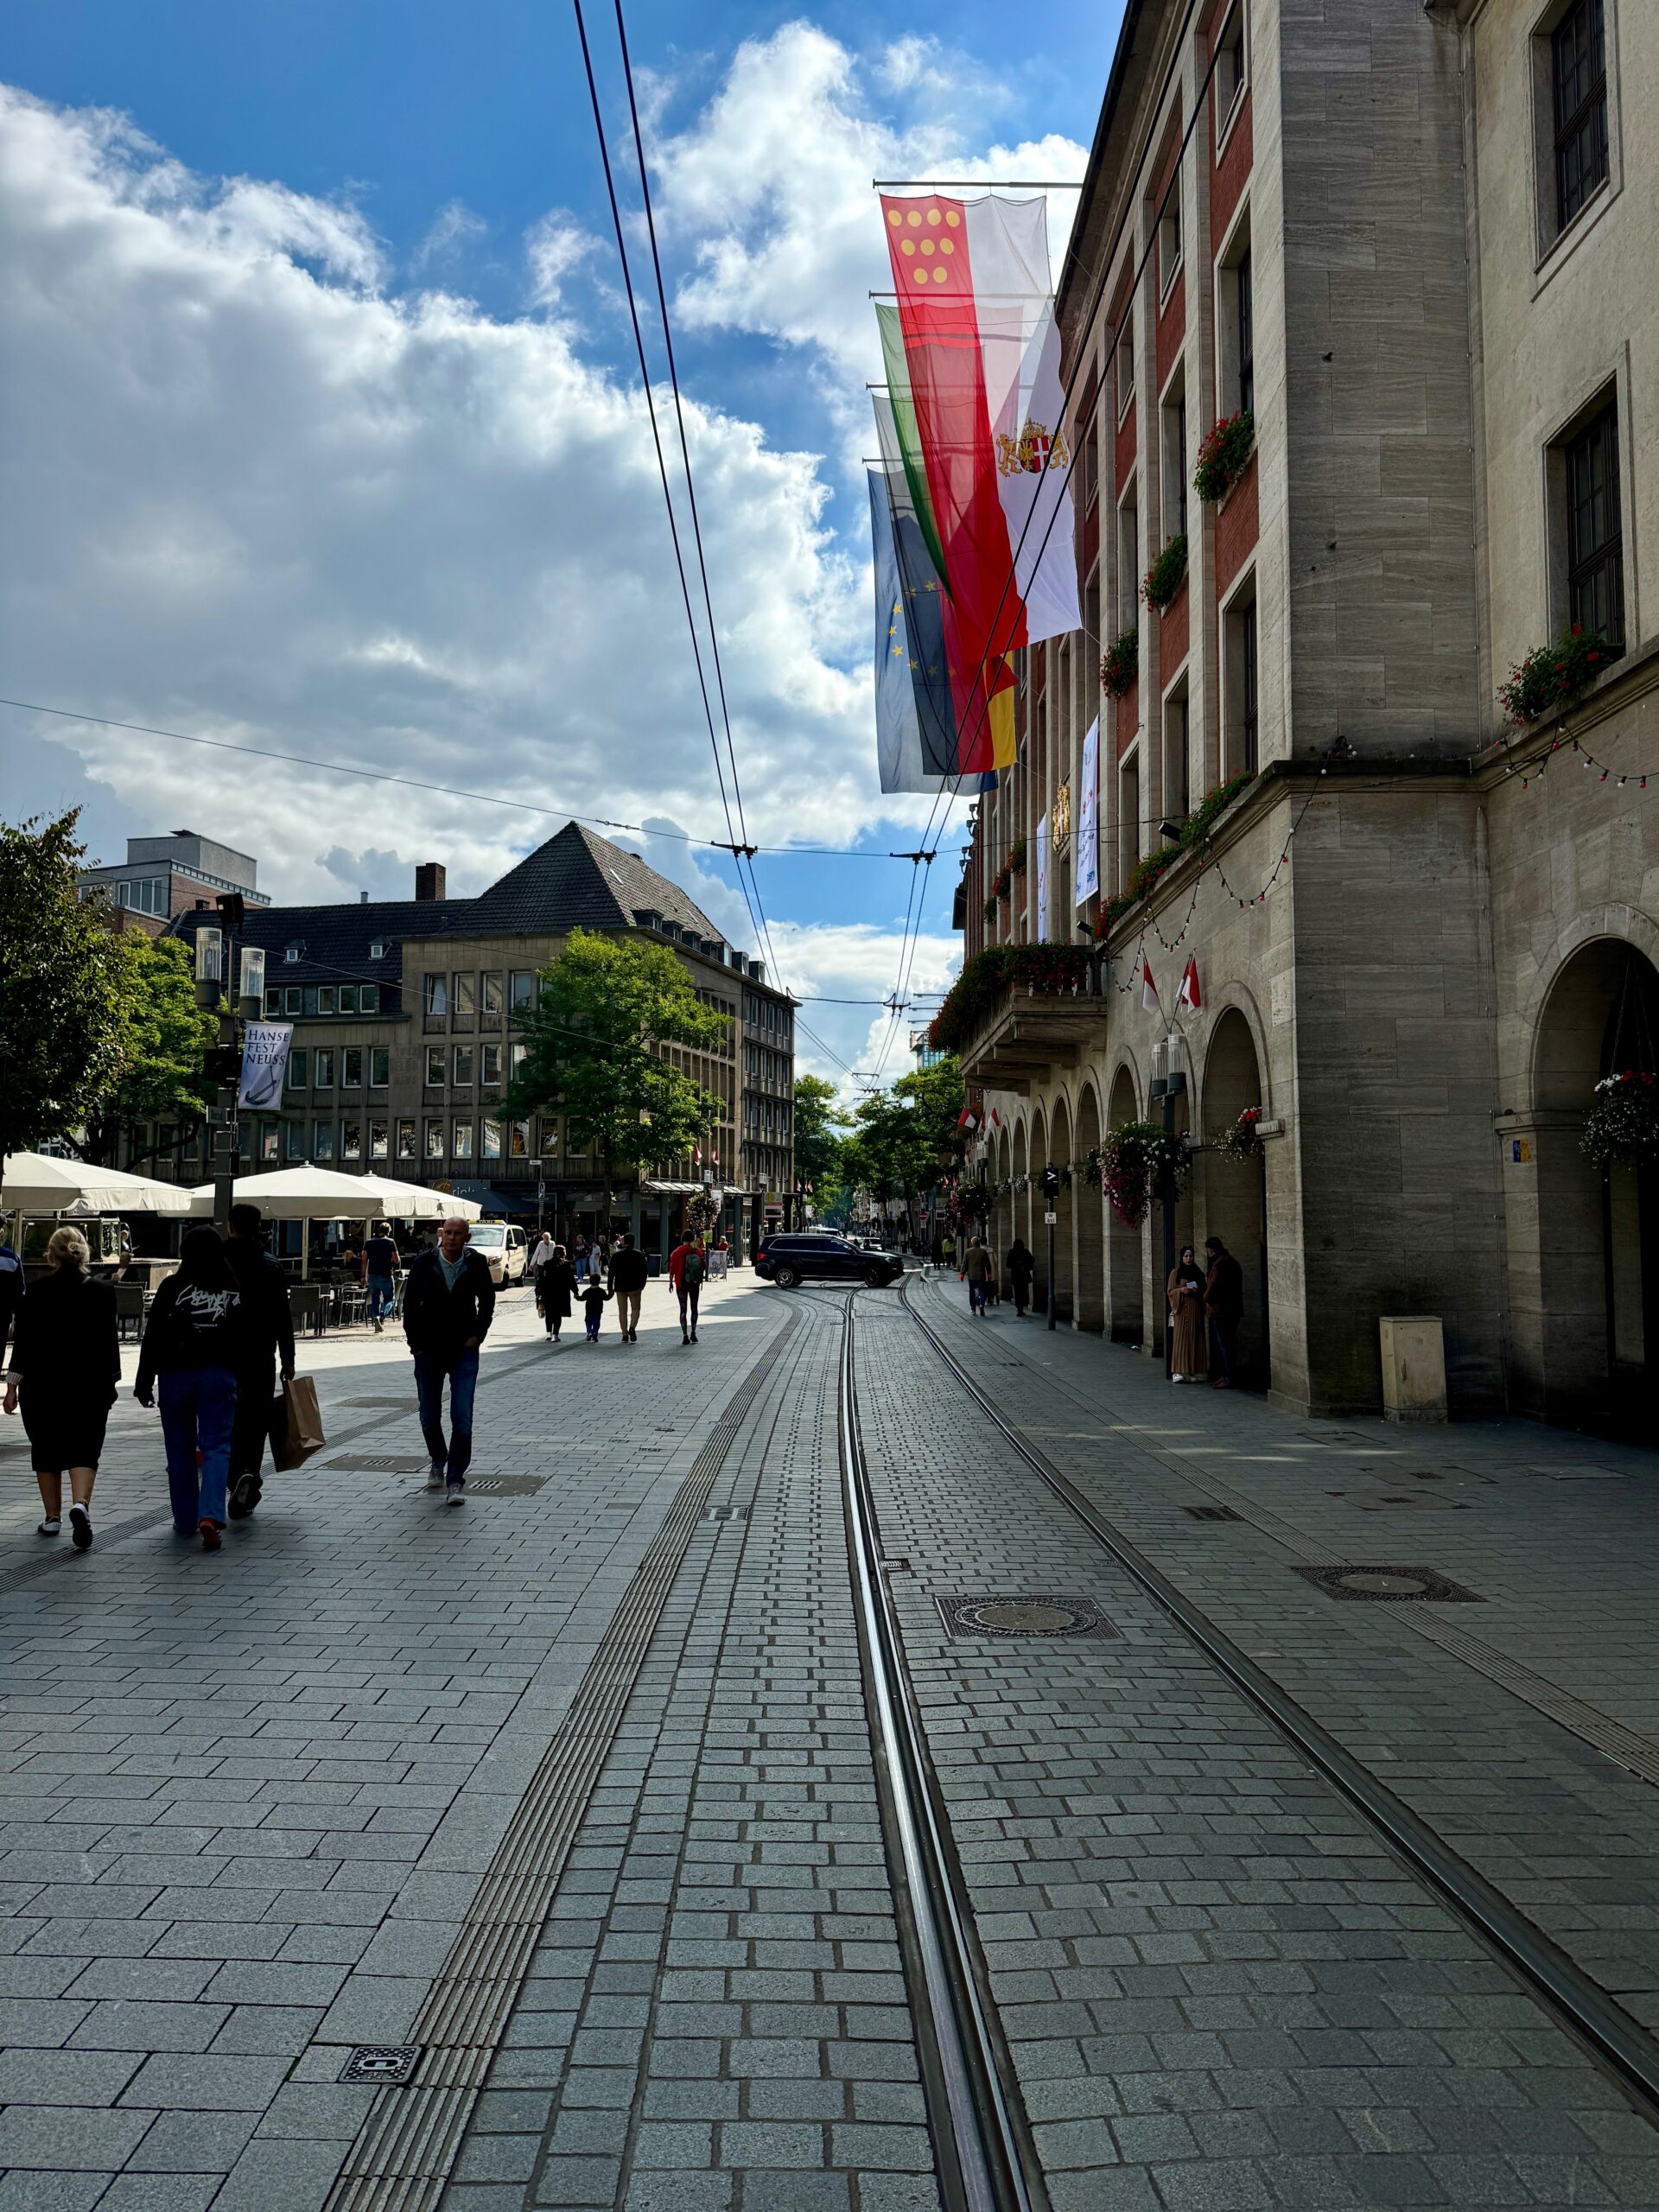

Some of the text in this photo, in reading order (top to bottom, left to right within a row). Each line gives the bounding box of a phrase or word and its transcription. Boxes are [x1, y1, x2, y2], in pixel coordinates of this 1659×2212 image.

[248, 1029, 289, 1042] HANSE
[247, 1042, 277, 1053] FEST
[246, 1053, 286, 1065] NEUSS
